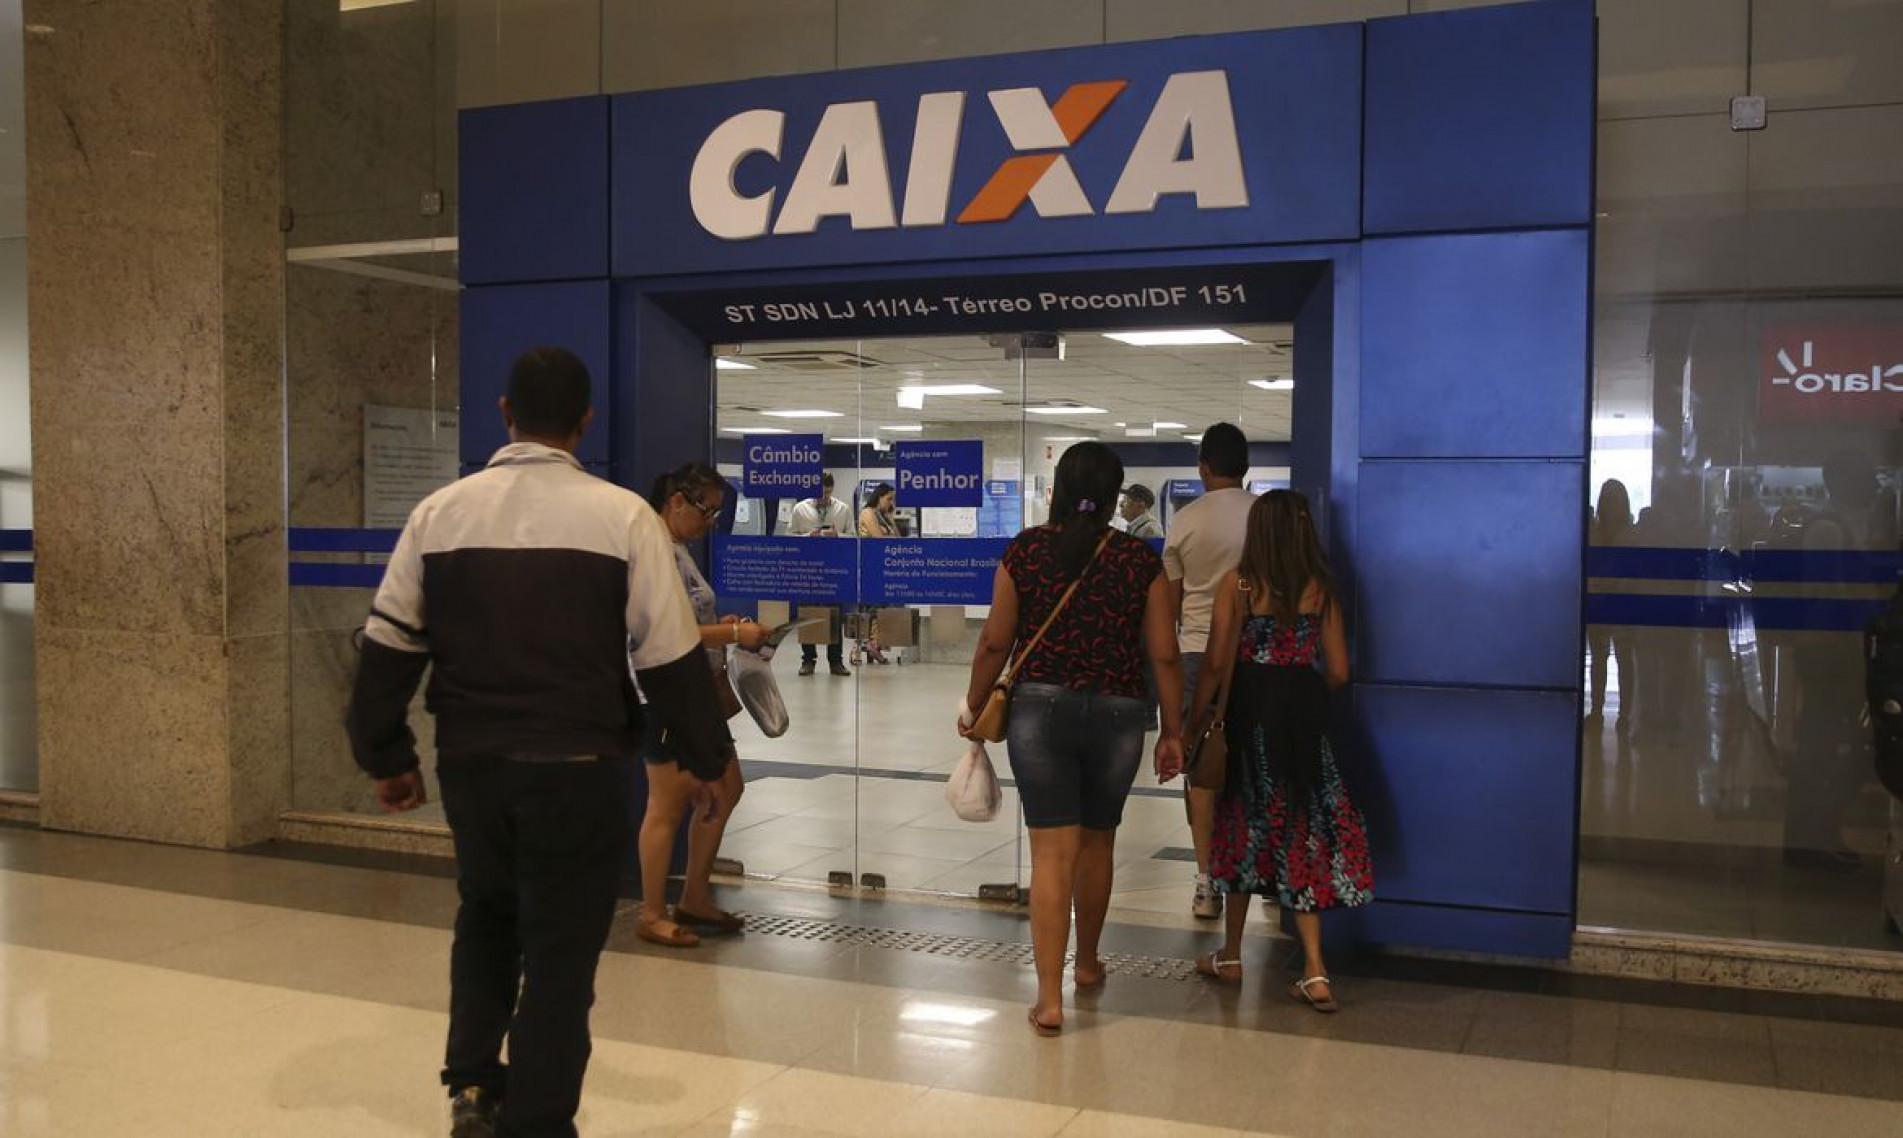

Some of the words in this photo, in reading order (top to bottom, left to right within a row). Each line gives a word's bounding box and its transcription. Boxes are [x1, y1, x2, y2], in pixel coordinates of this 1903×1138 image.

[689, 69, 1250, 240] CAIXA
[725, 305, 756, 323] ST
[763, 302, 820, 322] SDN
[824, 300, 856, 319] LJ
[942, 295, 1032, 316] Térreo
[1038, 287, 1188, 312] Procon/DF
[1198, 284, 1248, 305] 151
[750, 445, 821, 464] Câmbio
[750, 469, 821, 488] Exchange
[900, 468, 980, 490] Penhor
[884, 544, 923, 556] Agência
[884, 557, 925, 568] Conjunto
[927, 558, 968, 567] Nacional
